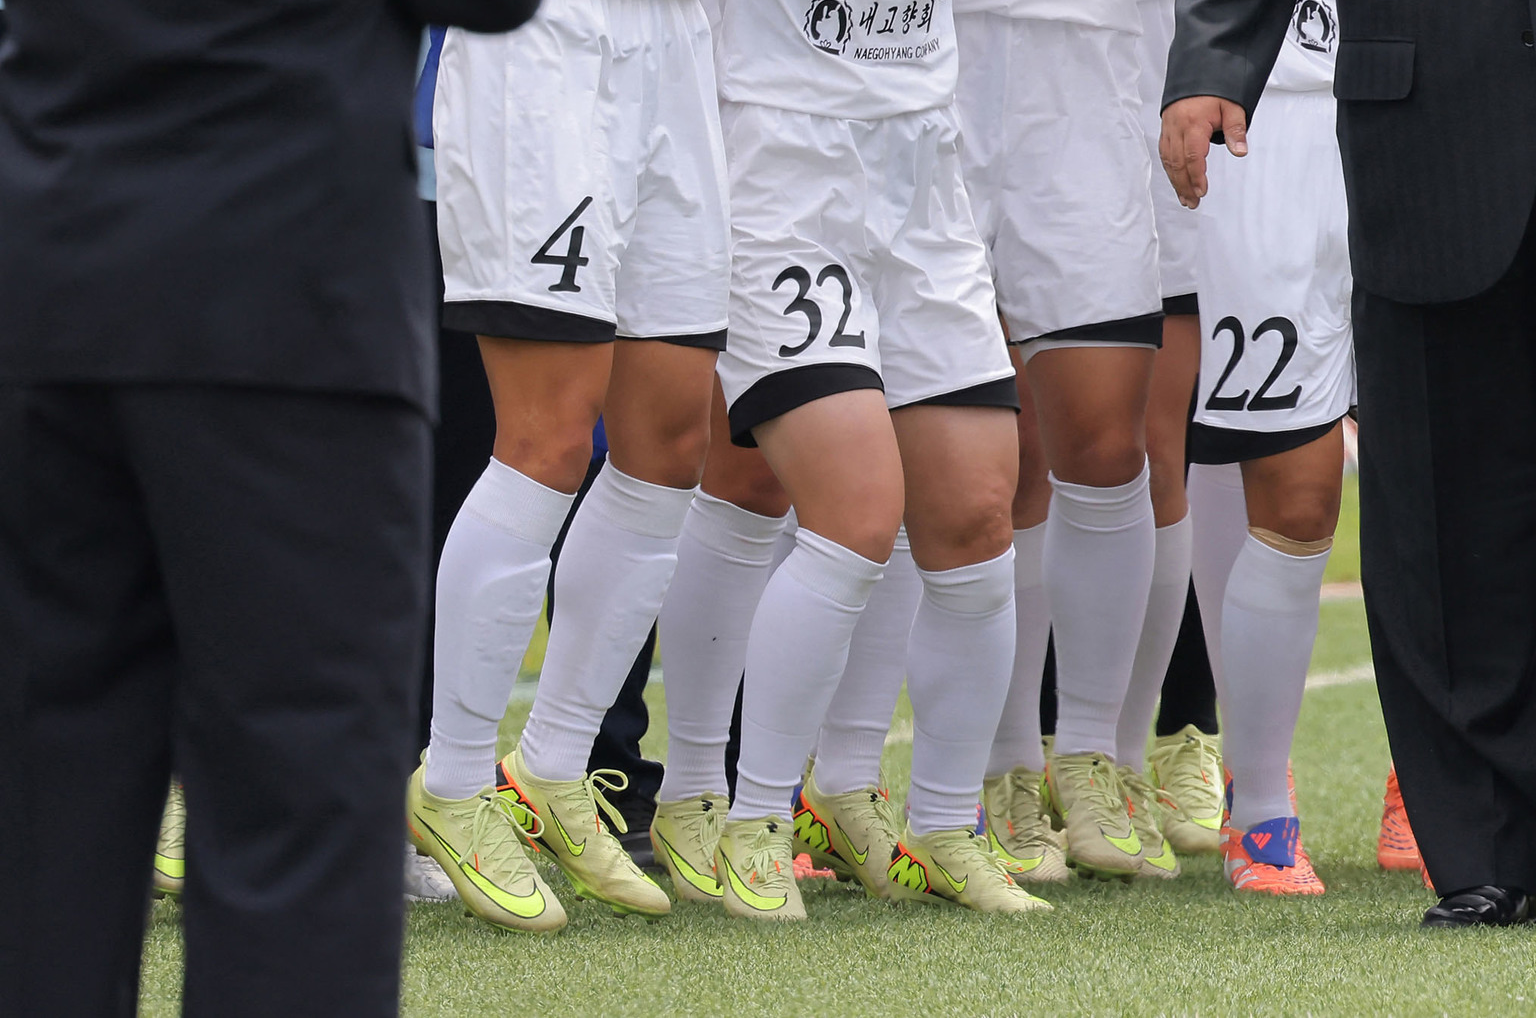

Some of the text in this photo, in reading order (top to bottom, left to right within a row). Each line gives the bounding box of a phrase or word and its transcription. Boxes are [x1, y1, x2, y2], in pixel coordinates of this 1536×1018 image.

[853, 45, 913, 60] NAEGOHYANG
[530, 195, 594, 293] 4
[770, 262, 867, 359] 32
[1204, 314, 1304, 413] 22
